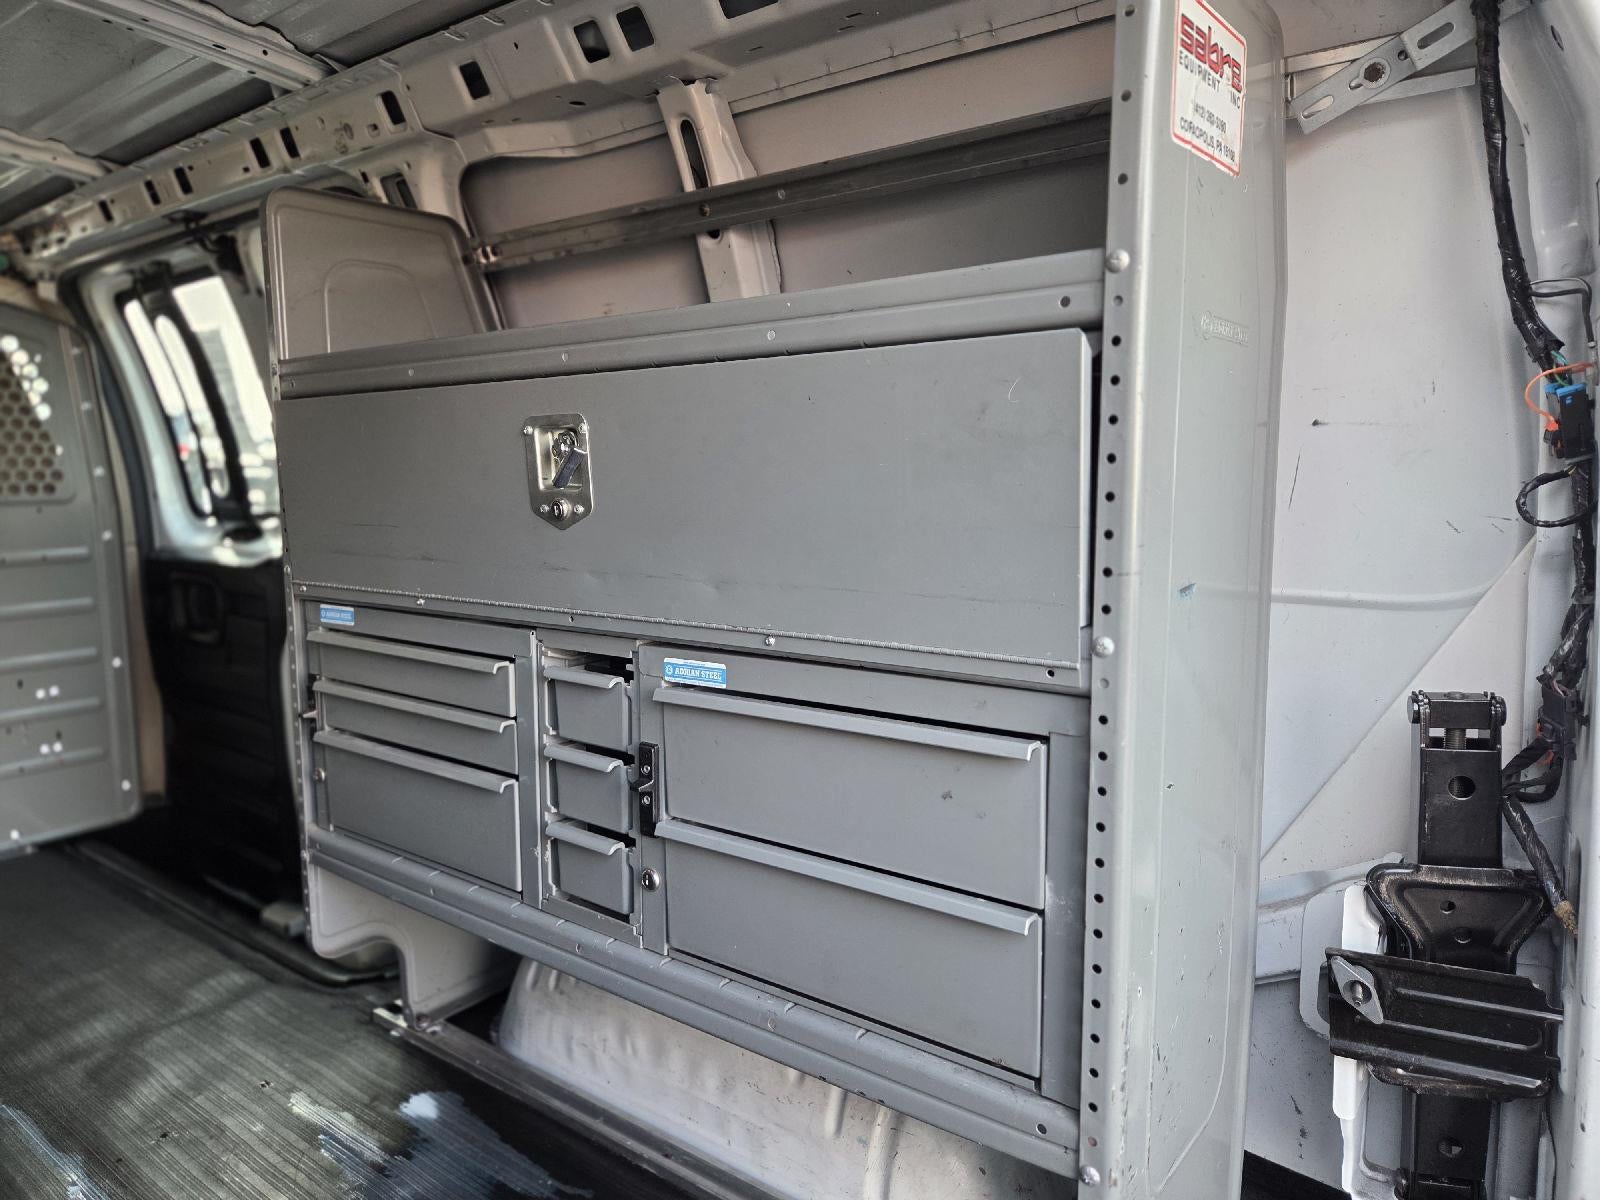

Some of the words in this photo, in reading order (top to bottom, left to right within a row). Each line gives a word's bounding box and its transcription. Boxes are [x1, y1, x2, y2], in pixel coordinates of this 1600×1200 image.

[1179, 50, 1221, 93] EQUIPMENT
[1230, 93, 1241, 110] INC
[701, 670, 722, 680] STEEL
